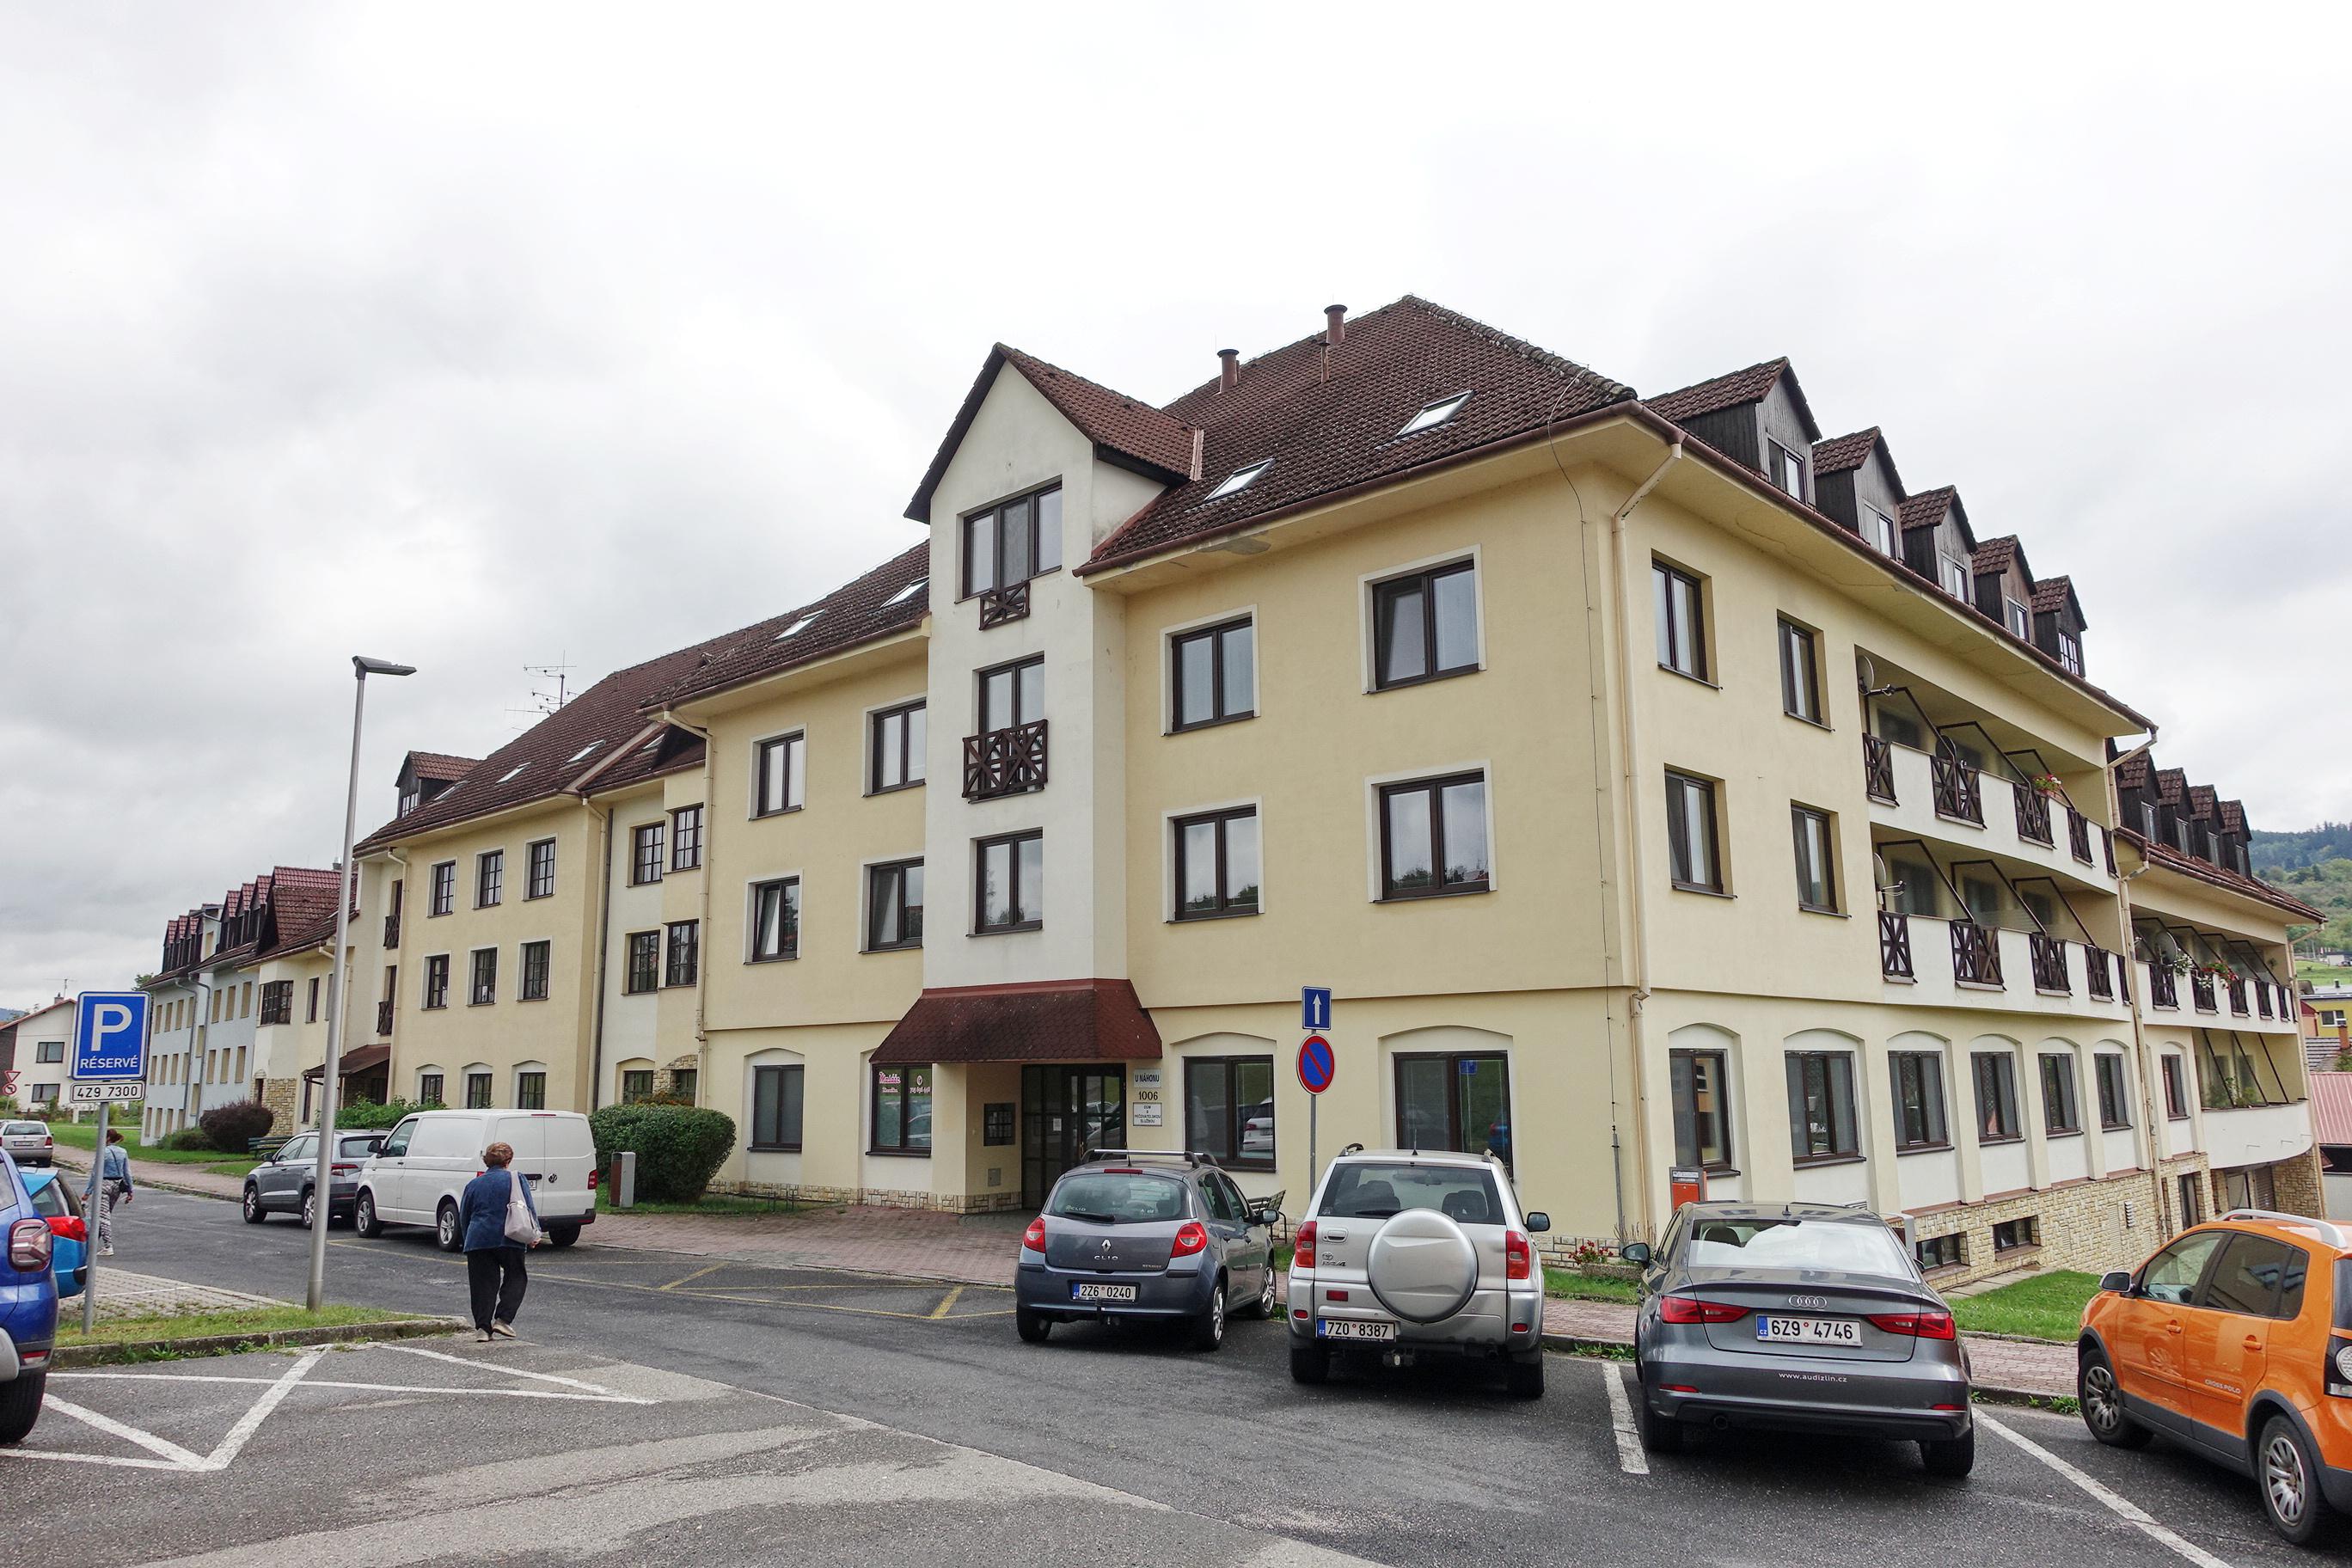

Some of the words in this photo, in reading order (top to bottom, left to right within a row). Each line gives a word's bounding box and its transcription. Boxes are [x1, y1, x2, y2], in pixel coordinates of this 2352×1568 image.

[90, 1003, 132, 1051] P
[80, 1055, 138, 1069] RÉSERVÉ
[77, 1087, 101, 1099] 4Z9
[107, 1086, 138, 1097] 7300
[1139, 1091, 1158, 1100] 1006
[1081, 1285, 1099, 1297] 2Z6
[1106, 1286, 1131, 1298] 0240
[1327, 1321, 1350, 1336] 7Z0
[1358, 1324, 1388, 1338] 8387
[1771, 1320, 1801, 1337] 6Z9
[1814, 1322, 1853, 1339] 4746
[1779, 1372, 1847, 1382] www.audizlin.cz
